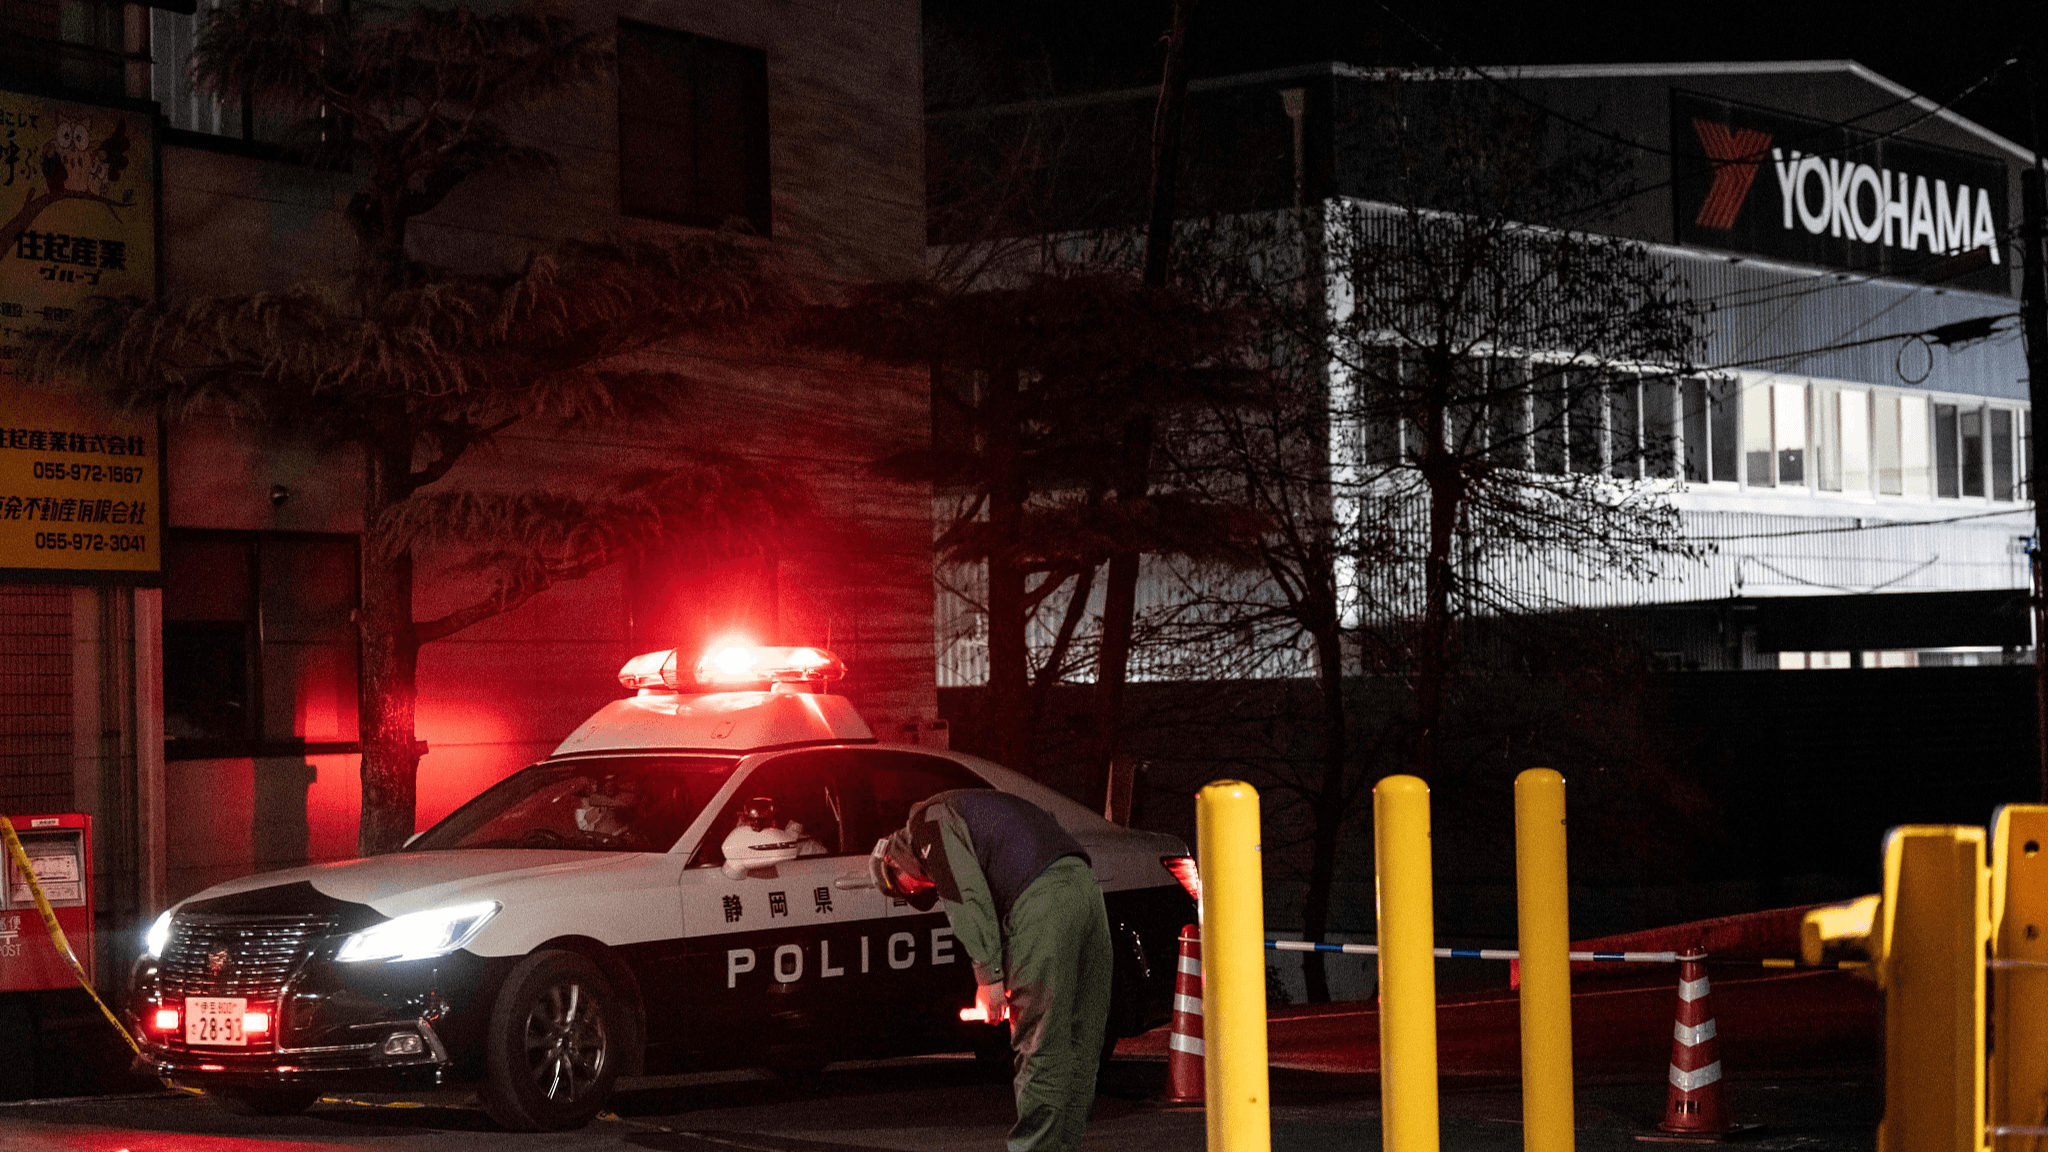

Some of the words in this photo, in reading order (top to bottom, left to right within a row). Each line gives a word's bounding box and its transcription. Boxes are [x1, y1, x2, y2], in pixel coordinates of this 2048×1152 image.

[1772, 146, 2001, 266] YOKOHAMA
[15, 230, 126, 271] 住起産業
[38, 264, 101, 286] グループ
[33, 461, 144, 484] 055-972-1567
[35, 532, 145, 552] 055-972-3041
[0, 943, 22, 957] OST
[727, 926, 956, 989] POLICE
